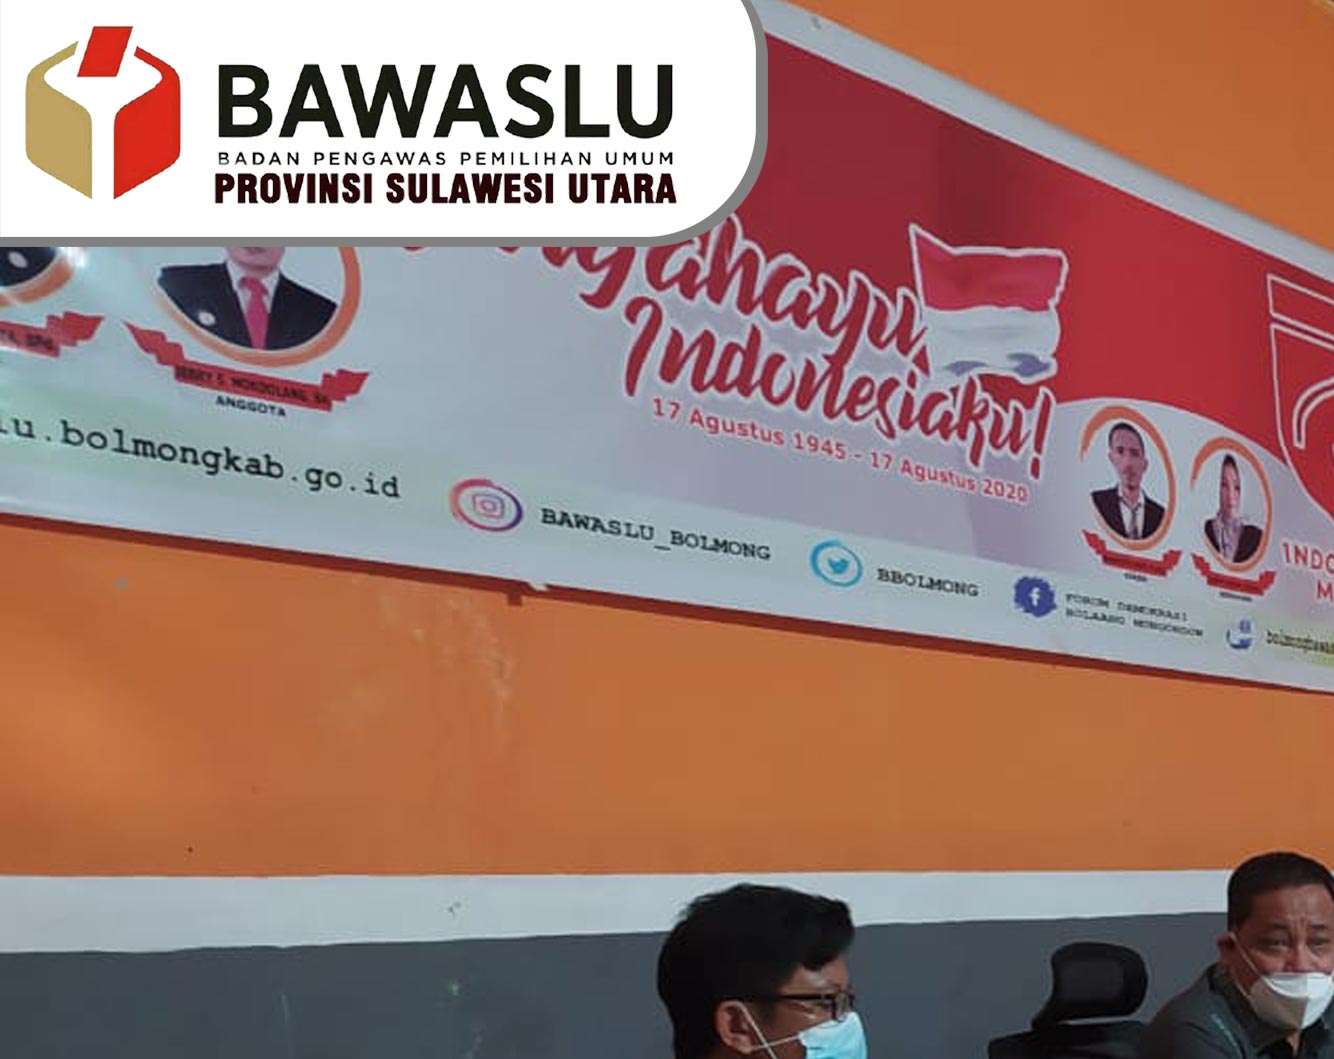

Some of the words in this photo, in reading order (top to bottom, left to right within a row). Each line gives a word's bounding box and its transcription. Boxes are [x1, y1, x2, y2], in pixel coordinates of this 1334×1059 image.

[214, 394, 287, 418] ANGGOTA
[624, 295, 1052, 480] Indonesiaku!
[0, 417, 400, 499] u.bolmongkab.go.id
[653, 397, 681, 420] 17
[689, 408, 785, 446] Agustus
[793, 431, 847, 460] 1945
[870, 451, 893, 471] 17
[899, 457, 977, 492] Agustus
[981, 479, 1029, 503] 2020
[540, 507, 772, 561] BAWASLU_BOLMONG
[876, 567, 980, 598] BBOLMONG
